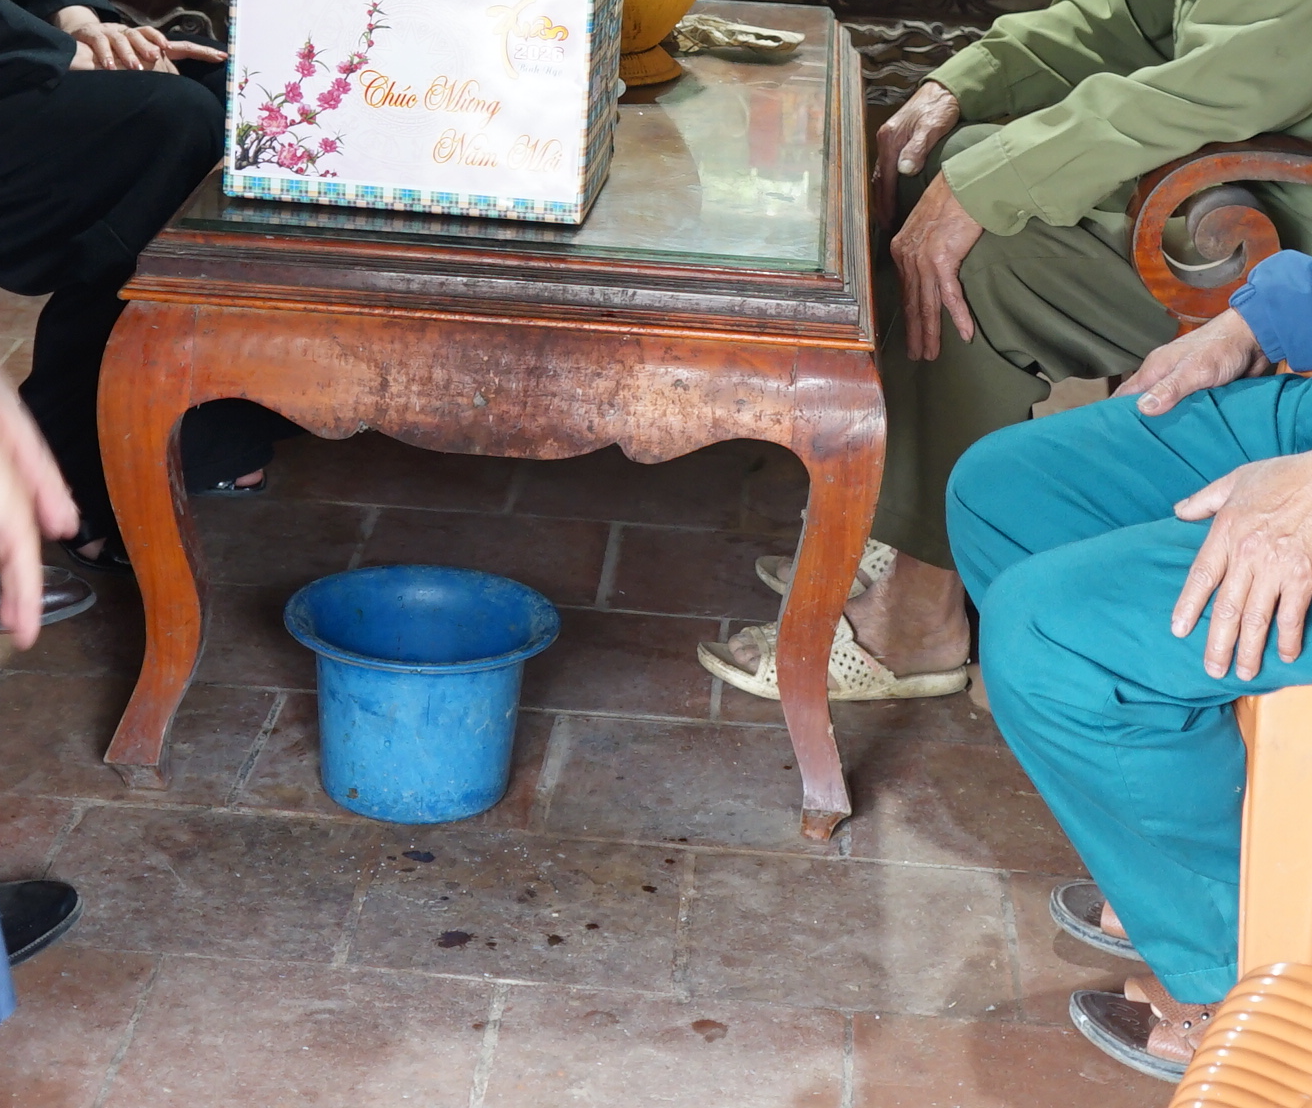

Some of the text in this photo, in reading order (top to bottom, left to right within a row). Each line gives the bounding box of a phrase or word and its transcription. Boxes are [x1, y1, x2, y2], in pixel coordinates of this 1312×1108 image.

[513, 43, 565, 63] 2026
[359, 69, 503, 130] Chúc Mừng
[432, 128, 564, 173] Năm Mới
